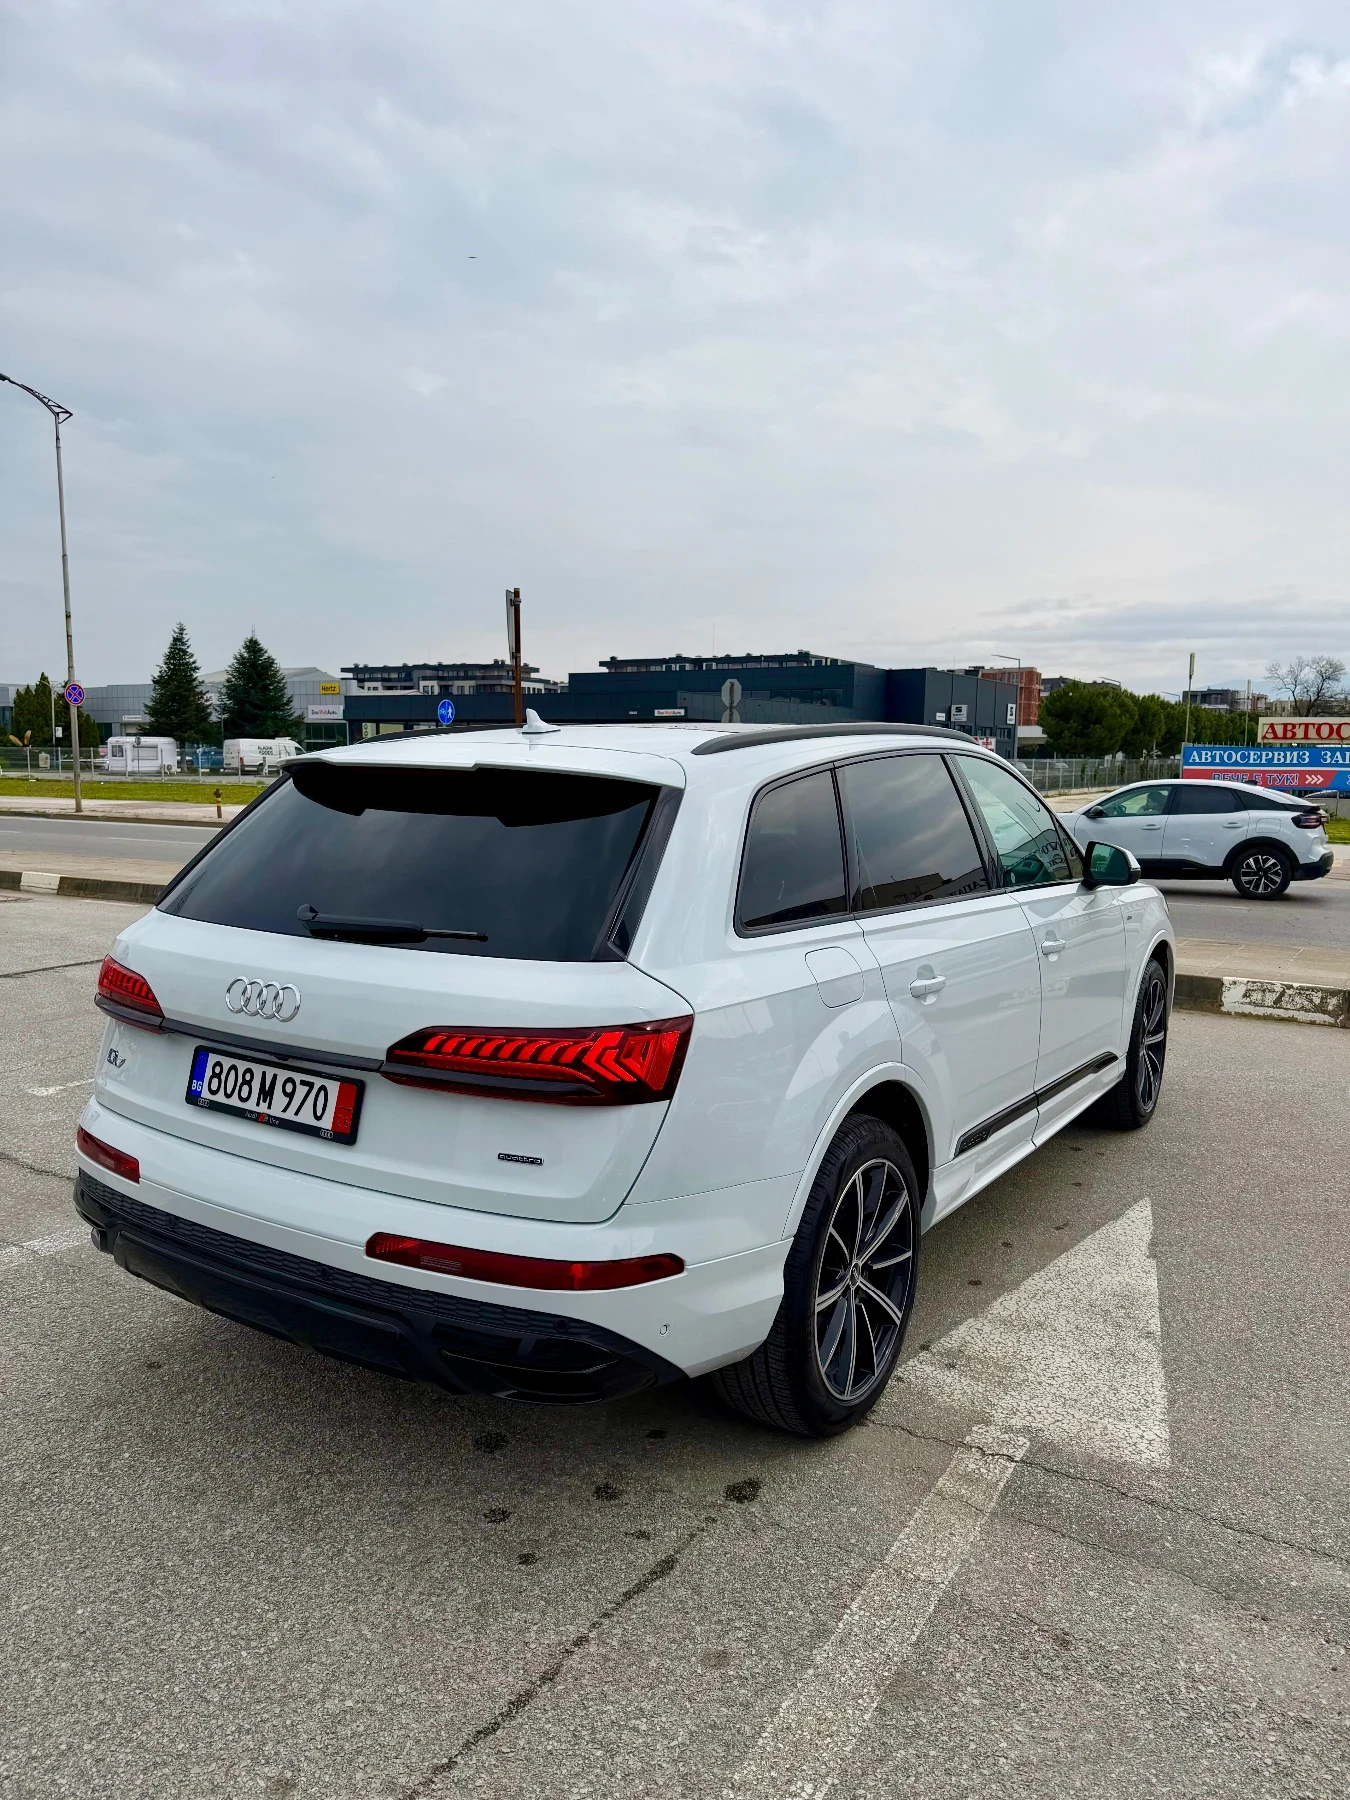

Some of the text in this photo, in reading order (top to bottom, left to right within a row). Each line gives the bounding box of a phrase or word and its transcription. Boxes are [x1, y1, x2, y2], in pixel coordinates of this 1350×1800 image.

[321, 685, 337, 693] Hertz
[1188, 750, 1310, 764] АВТОСЕРВИЗ
[1266, 773, 1299, 786] ТУК!
[191, 1079, 203, 1091] BG
[498, 1153, 543, 1165] quattro
